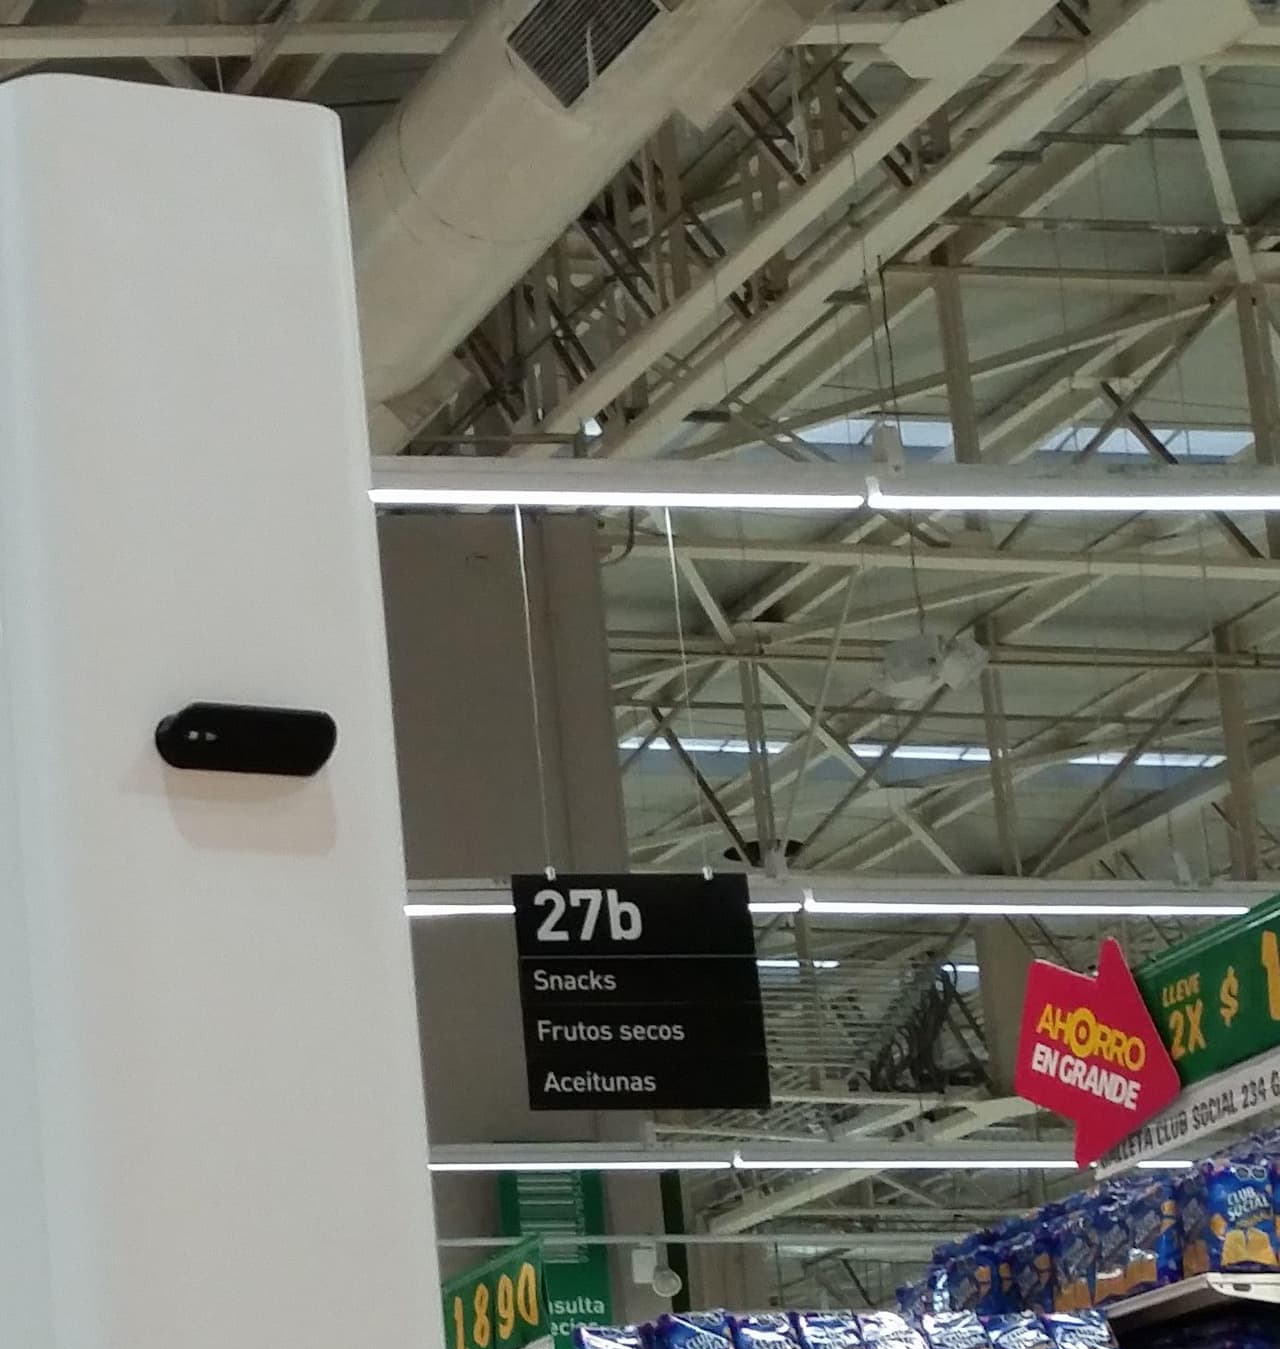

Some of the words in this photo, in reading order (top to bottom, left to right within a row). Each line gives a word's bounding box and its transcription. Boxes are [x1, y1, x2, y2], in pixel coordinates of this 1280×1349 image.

[534, 888, 643, 942] 27b
[533, 968, 618, 992] Snacks
[537, 1019, 614, 1042] Frutos
[619, 1025, 686, 1042] secos
[1036, 1003, 1146, 1072] AHORRO
[1168, 998, 1207, 1061] 2X
[543, 1069, 657, 1092] Aceitunas
[1031, 1042, 1060, 1079] EN
[1059, 1055, 1141, 1111] GRANDE
[1154, 1111, 1188, 1147] CLUB
[1227, 1186, 1255, 1206] CLUB
[1228, 1192, 1270, 1222] SOCIAL
